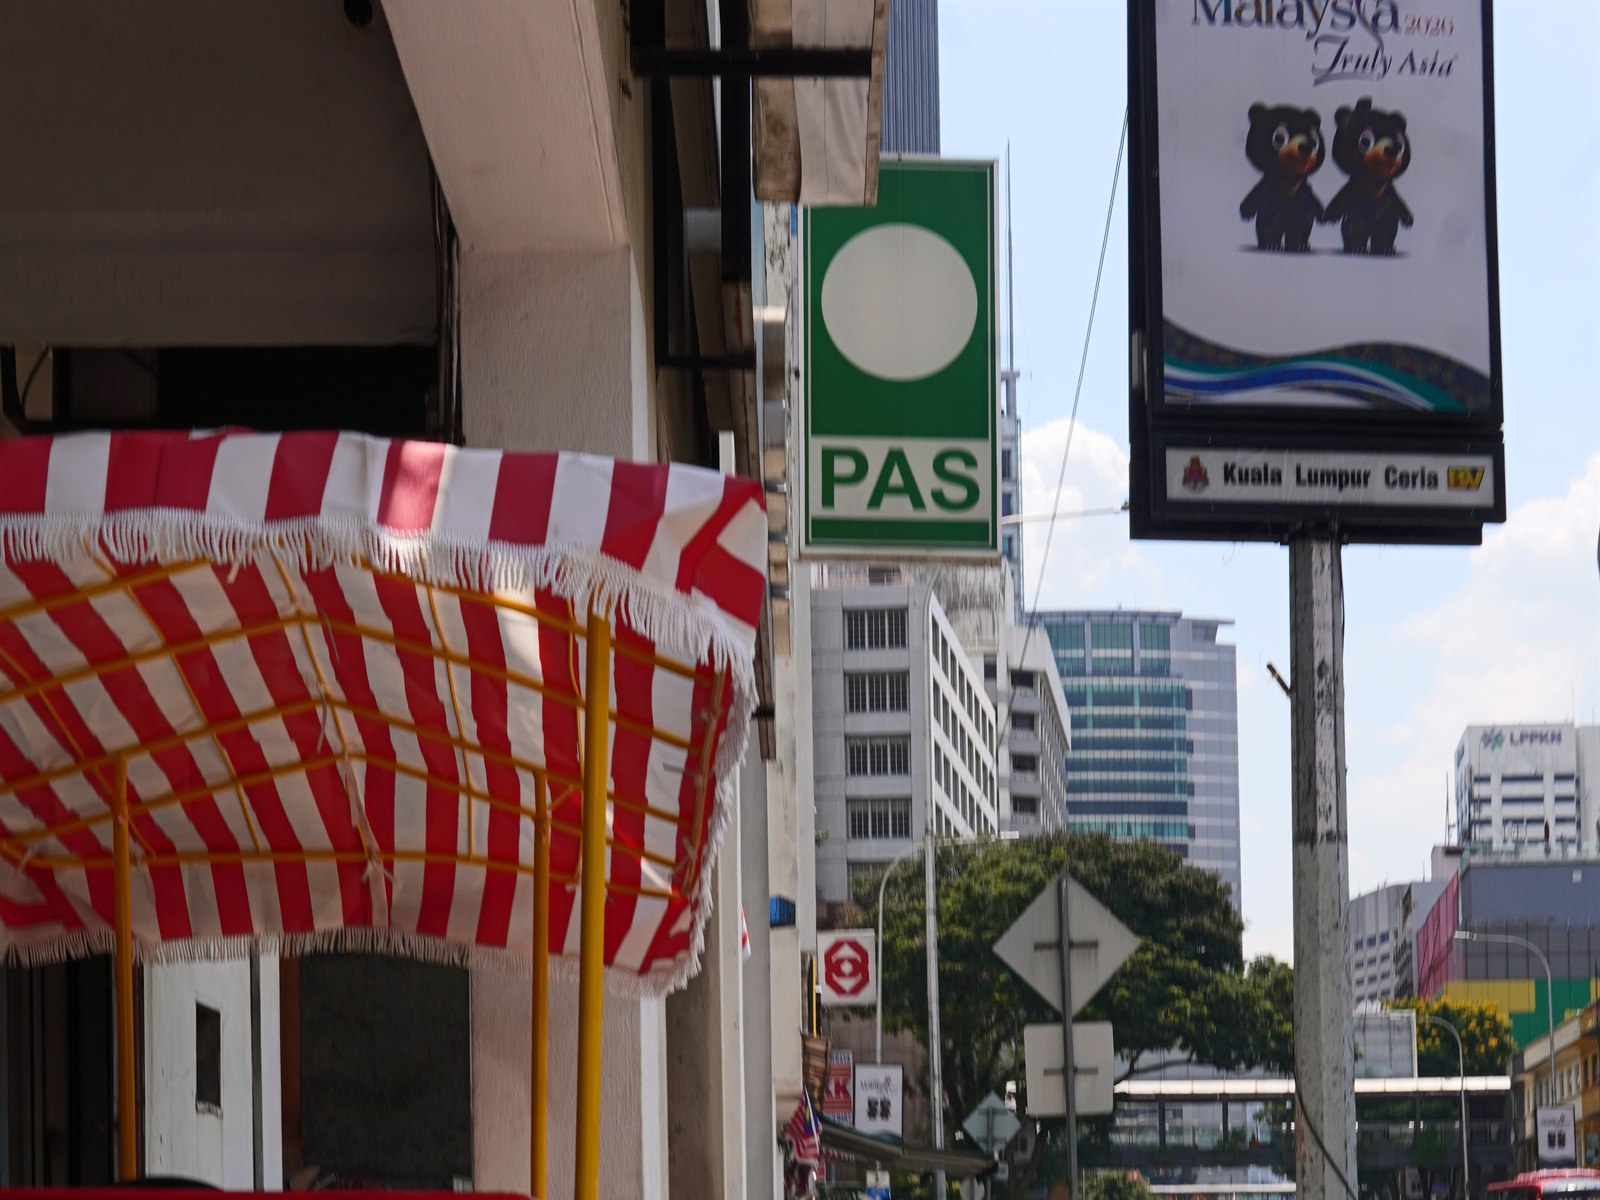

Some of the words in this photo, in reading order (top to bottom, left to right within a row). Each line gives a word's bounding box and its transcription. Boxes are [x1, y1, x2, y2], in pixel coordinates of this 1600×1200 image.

[1311, 34, 1392, 86] Truly
[1398, 49, 1455, 78] Asia
[821, 446, 981, 513] PAS
[1223, 461, 1283, 487] Kuala
[1295, 463, 1371, 491] Lumpur
[1384, 464, 1439, 489] Ceria
[1509, 728, 1562, 746] LPPKN
